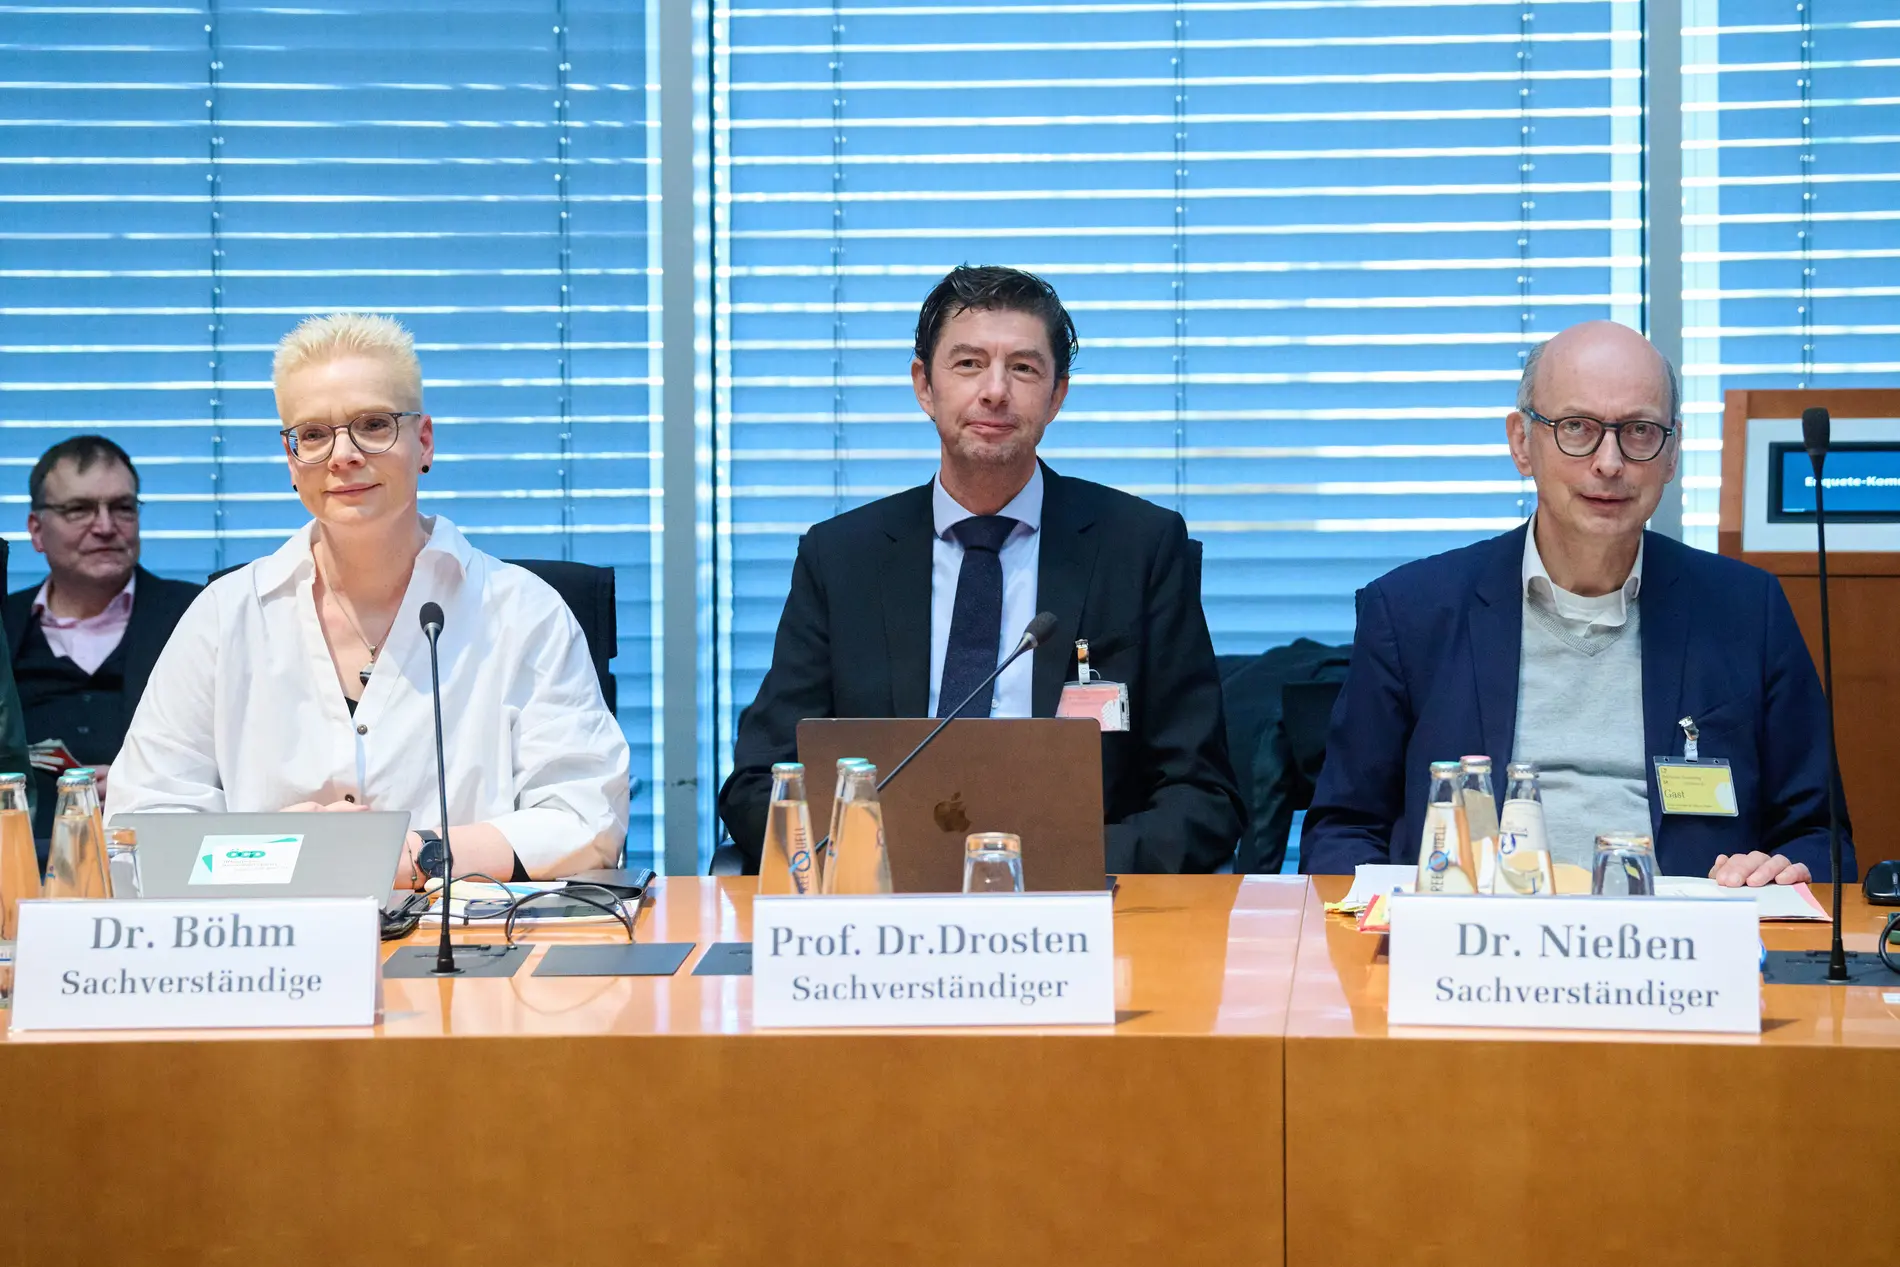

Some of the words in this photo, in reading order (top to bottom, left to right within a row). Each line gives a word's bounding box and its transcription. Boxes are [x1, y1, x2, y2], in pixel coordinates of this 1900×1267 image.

[1805, 475, 1900, 489] Equete-Kom
[1664, 789, 1685, 799] Gast
[90, 916, 154, 950] Dr.
[171, 913, 297, 949] Böhm
[769, 923, 861, 957] Prof.
[1456, 921, 1521, 958] Dr.
[1537, 923, 1697, 961] Nießen
[61, 967, 322, 1000] Sachverständige
[792, 972, 1068, 1006] Sachverständiger
[1435, 975, 1719, 1016] Sachverständiger
